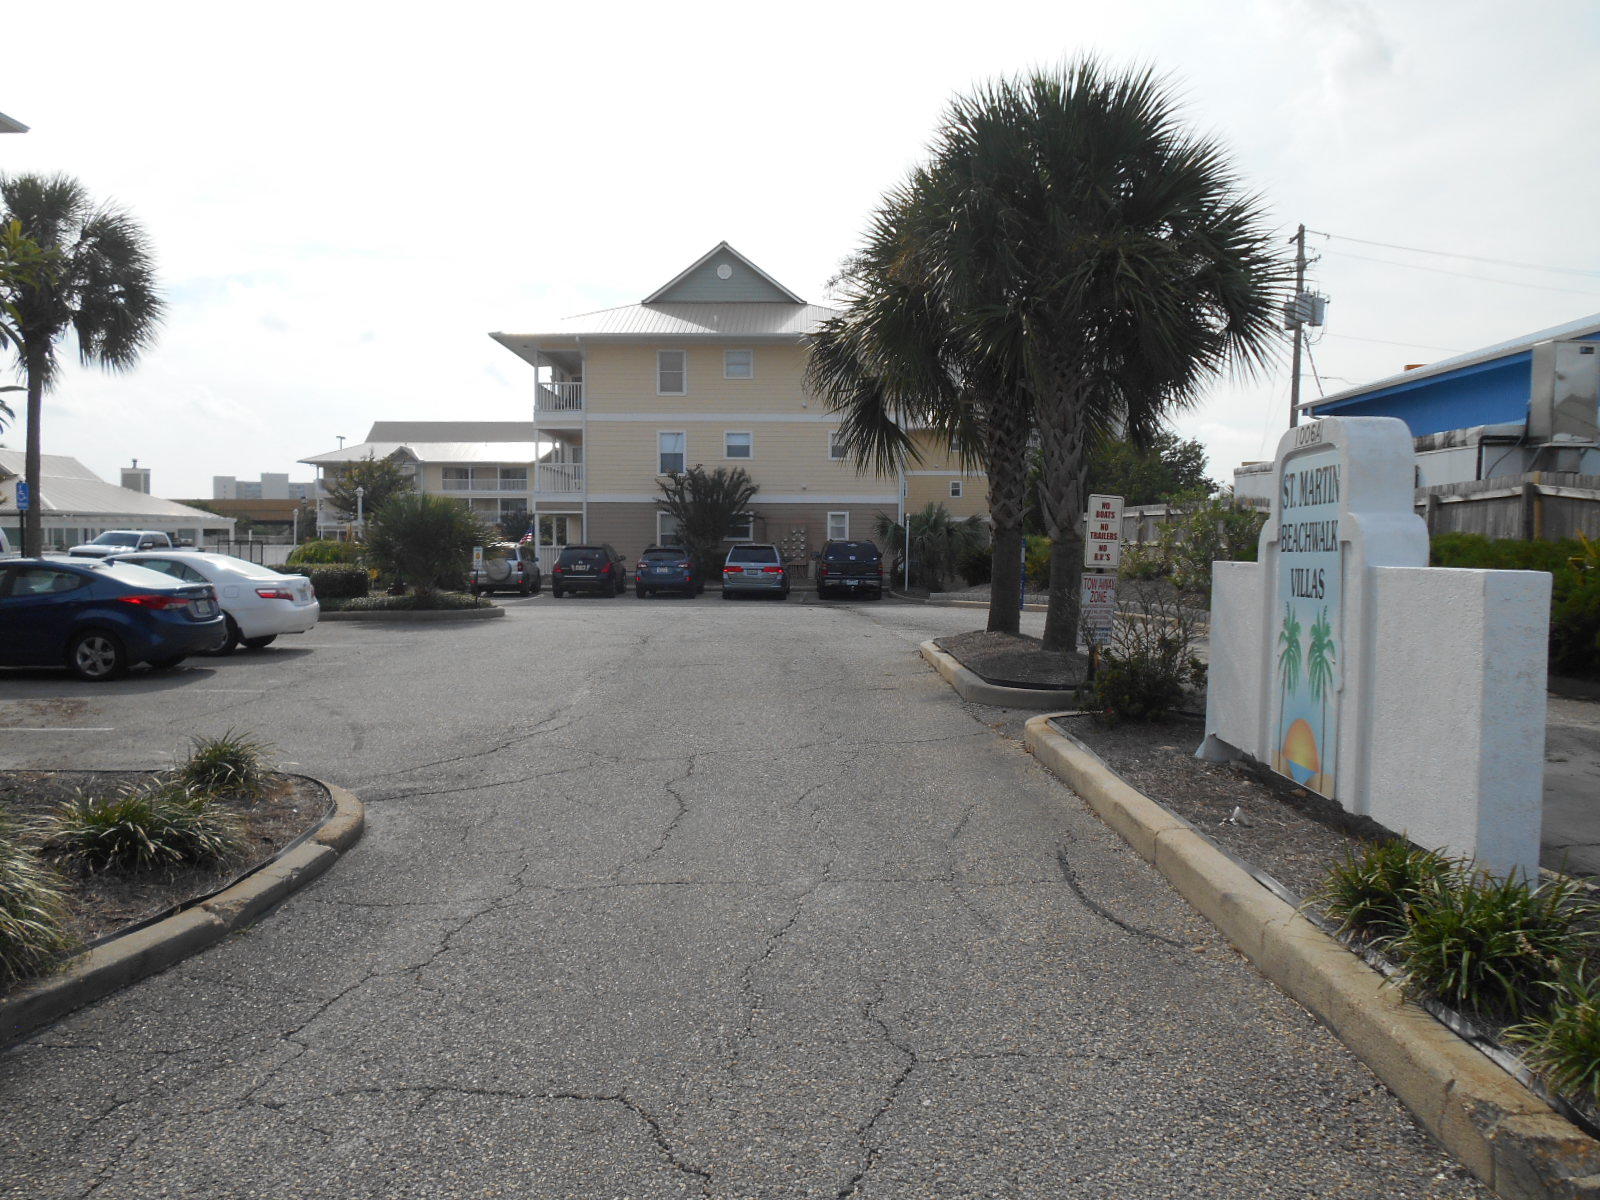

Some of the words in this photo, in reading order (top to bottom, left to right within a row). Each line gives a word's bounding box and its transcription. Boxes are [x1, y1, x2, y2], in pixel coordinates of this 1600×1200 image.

[1295, 423, 1322, 448] 10064
[1282, 473, 1296, 510] ST.
[1299, 463, 1342, 508] MARTIN
[1101, 501, 1111, 510] NO
[1096, 511, 1116, 519] BOATS
[1100, 523, 1109, 531] NO
[1090, 531, 1118, 540] TRAILERS
[1281, 520, 1339, 553] BEACHWALK
[1098, 544, 1108, 552] NO
[1290, 568, 1326, 600] VILLAS
[1089, 590, 1108, 603] ZONE
